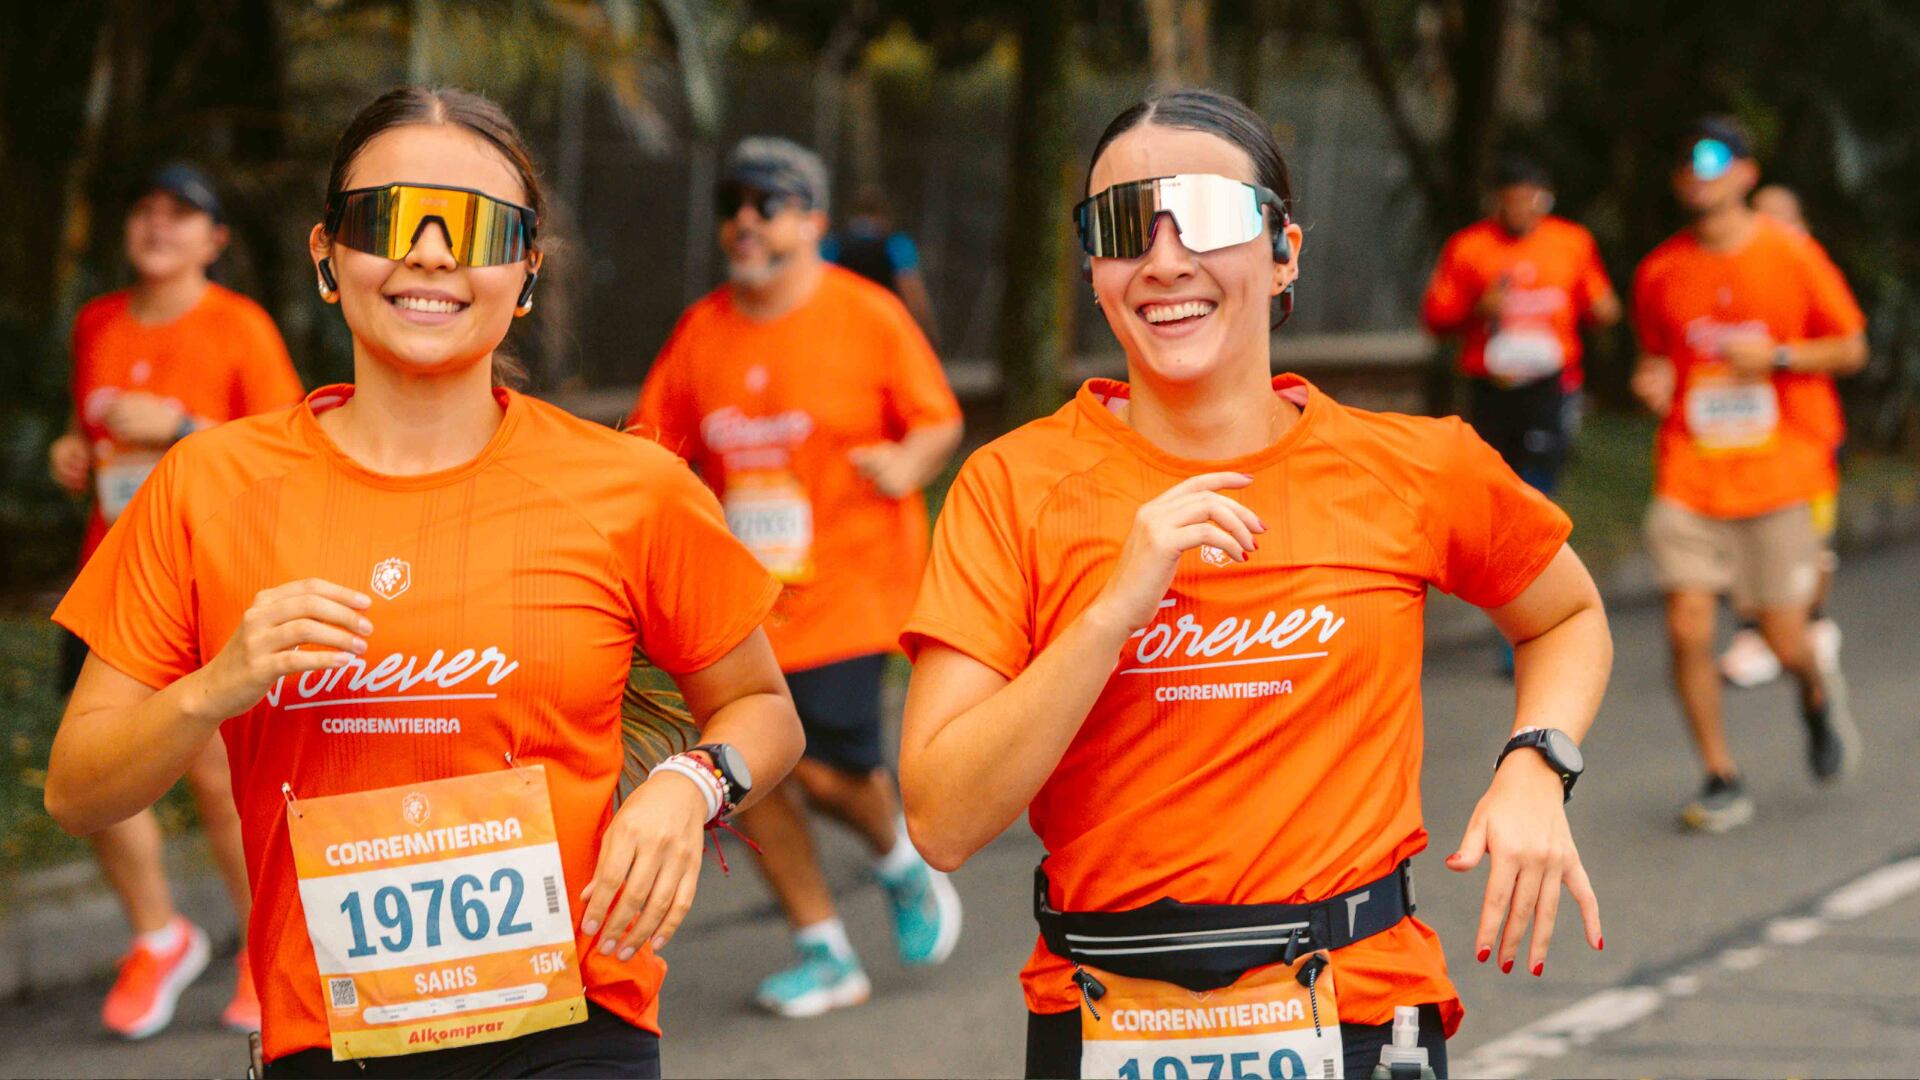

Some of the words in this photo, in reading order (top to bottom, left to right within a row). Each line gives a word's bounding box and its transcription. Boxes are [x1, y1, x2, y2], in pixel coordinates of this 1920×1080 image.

[266, 646, 519, 708] orever
[1155, 680, 1293, 702] CORREMITIERRA
[321, 717, 461, 734] CORREMITIERRA
[325, 817, 523, 867] CORREMITIERRA
[340, 867, 533, 959] 19762
[529, 951, 567, 975] 15K
[414, 966, 478, 994] SARIS
[1111, 998, 1305, 1032] CORREMITIERRA
[408, 1020, 505, 1044] Alkomprar
